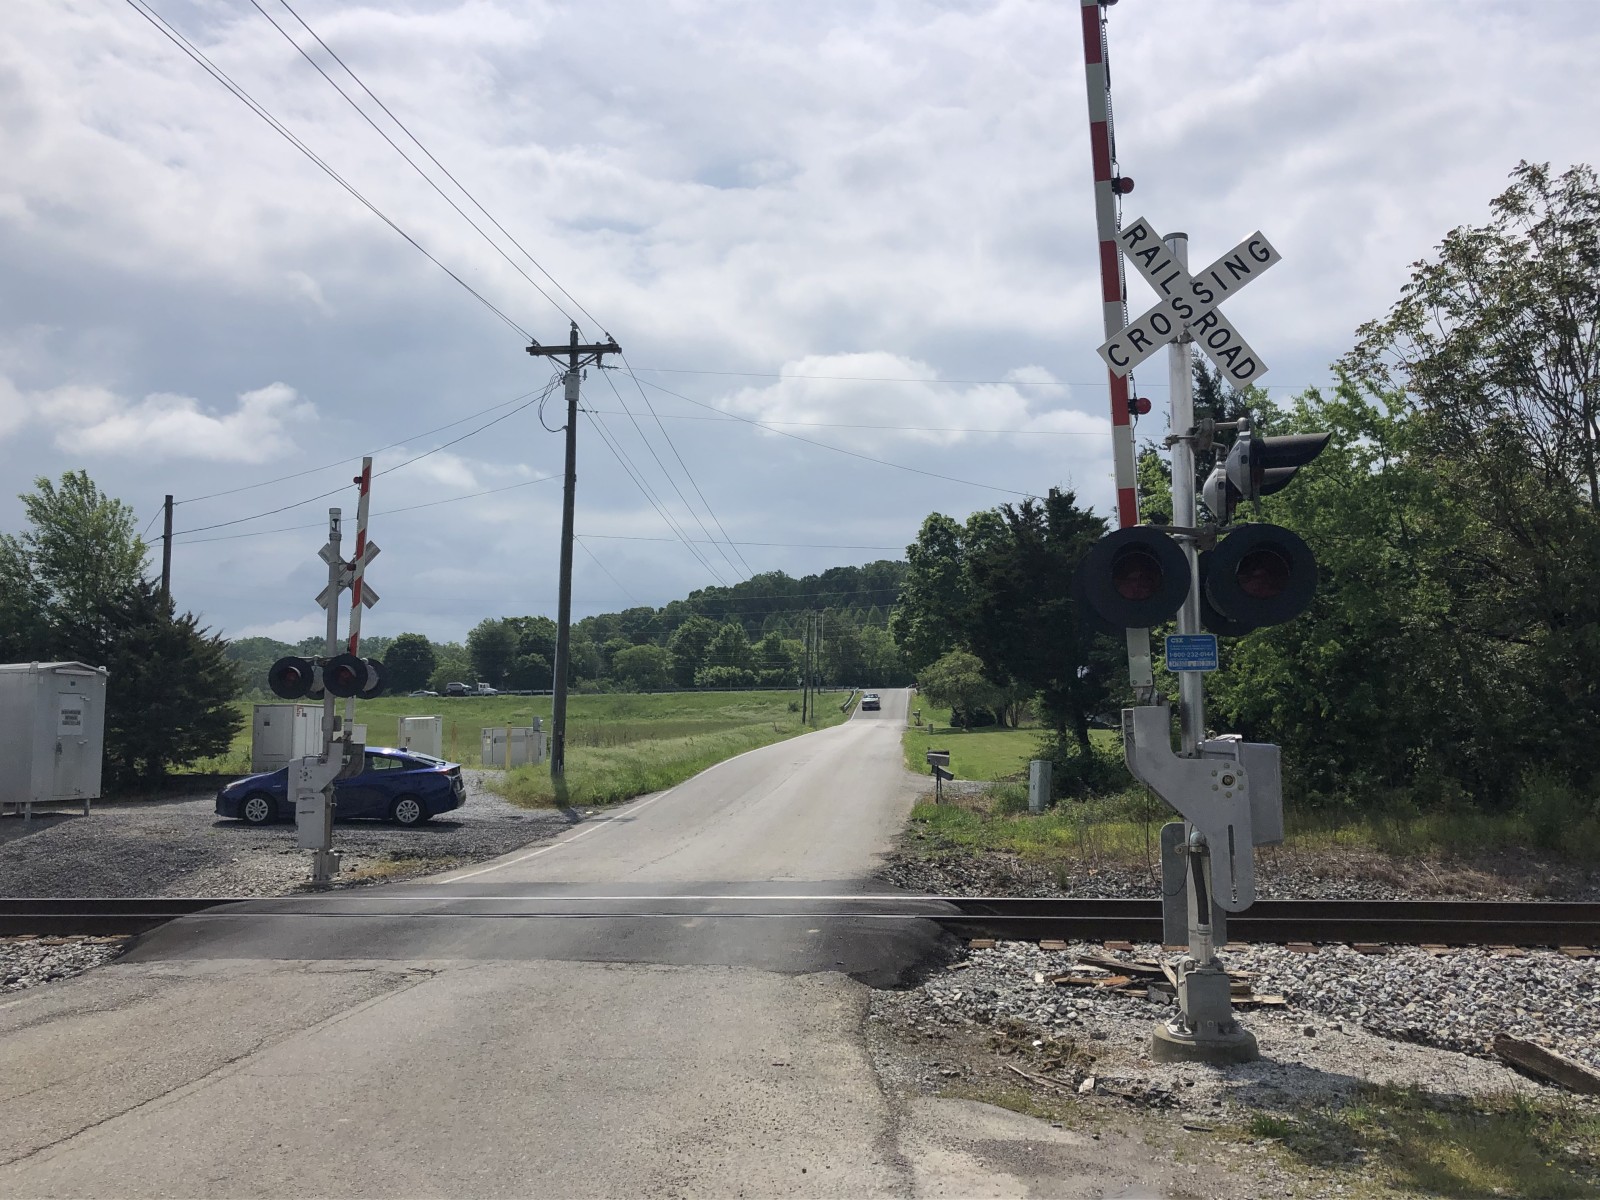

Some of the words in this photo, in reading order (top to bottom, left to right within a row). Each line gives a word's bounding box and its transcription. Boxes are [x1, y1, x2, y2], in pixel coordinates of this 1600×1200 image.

[1107, 240, 1270, 367] CROSSING
[1122, 224, 1181, 295] RAIL
[1192, 310, 1256, 380] ROAD
